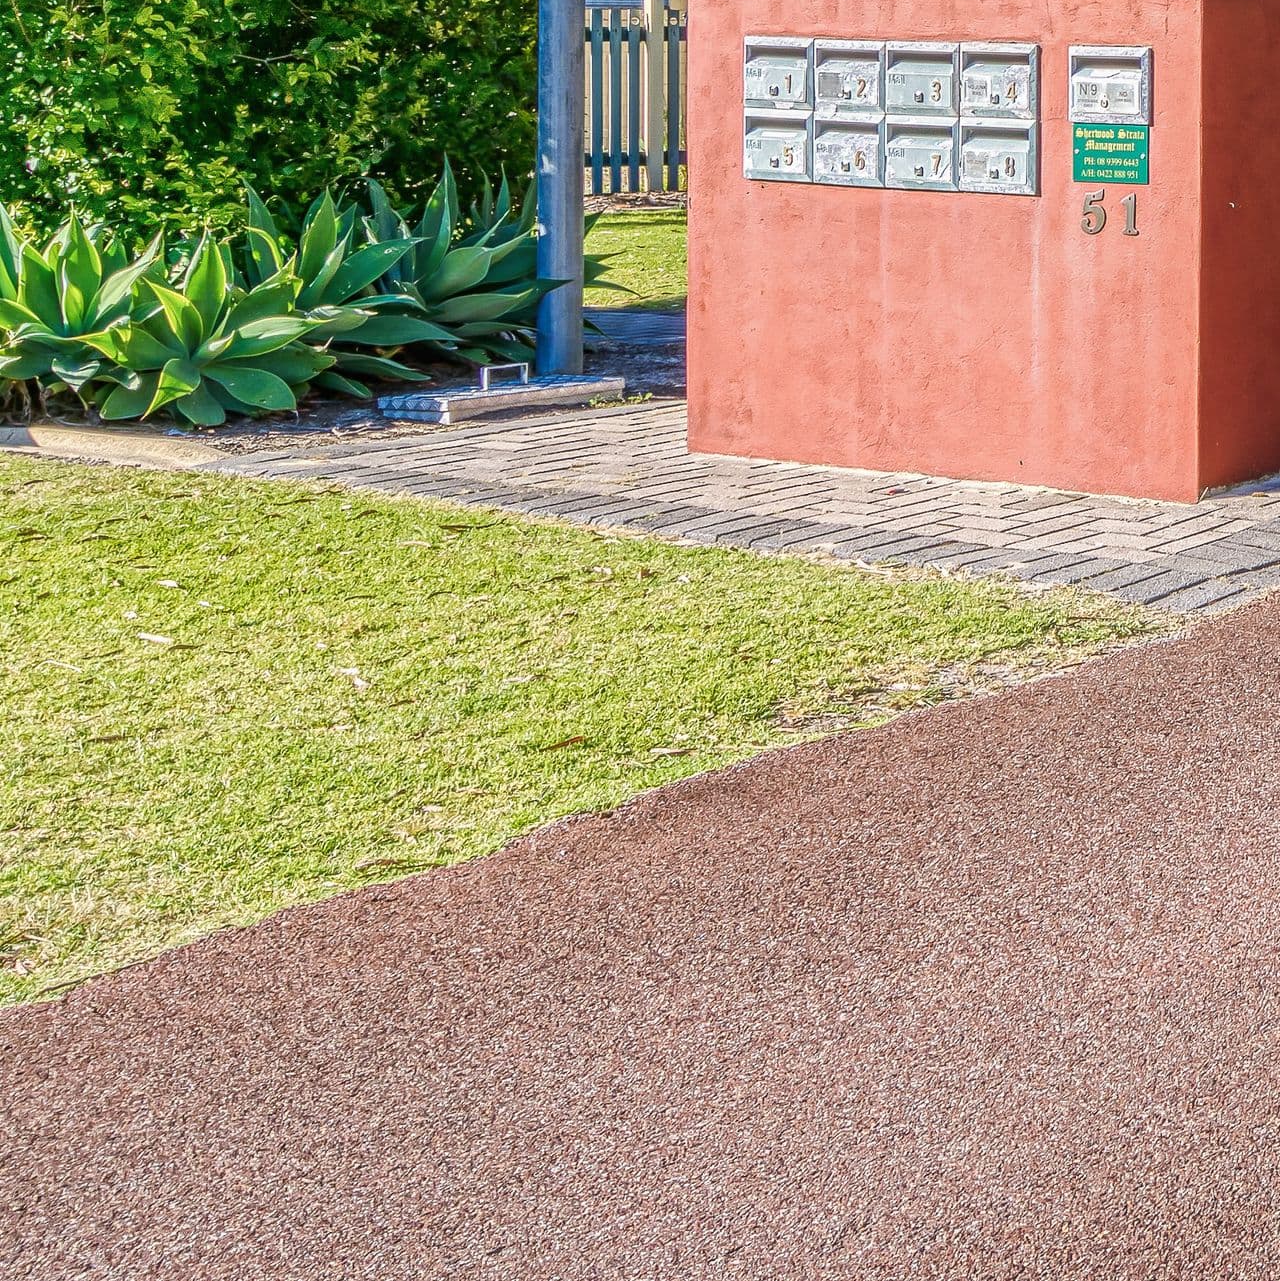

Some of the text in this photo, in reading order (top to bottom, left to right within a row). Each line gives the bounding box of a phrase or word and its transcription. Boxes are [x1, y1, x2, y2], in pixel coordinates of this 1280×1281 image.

[784, 73, 792, 94] 1
[857, 78, 867, 98] 2
[931, 80, 942, 102] 3
[1006, 81, 1018, 103] 4
[1075, 127, 1145, 140] Sherwood Strata
[783, 144, 794, 166] 5
[1085, 140, 1136, 152] Management
[854, 150, 866, 170] 6
[931, 153, 942, 175] 7
[1005, 156, 1016, 178] 8
[1084, 157, 1096, 166] PH:
[1096, 157, 1105, 166] 08
[1081, 169, 1096, 178] A/H:
[1096, 170, 1113, 178] 0422
[1127, 171, 1139, 179] 951
[1080, 188, 1140, 237] 51
